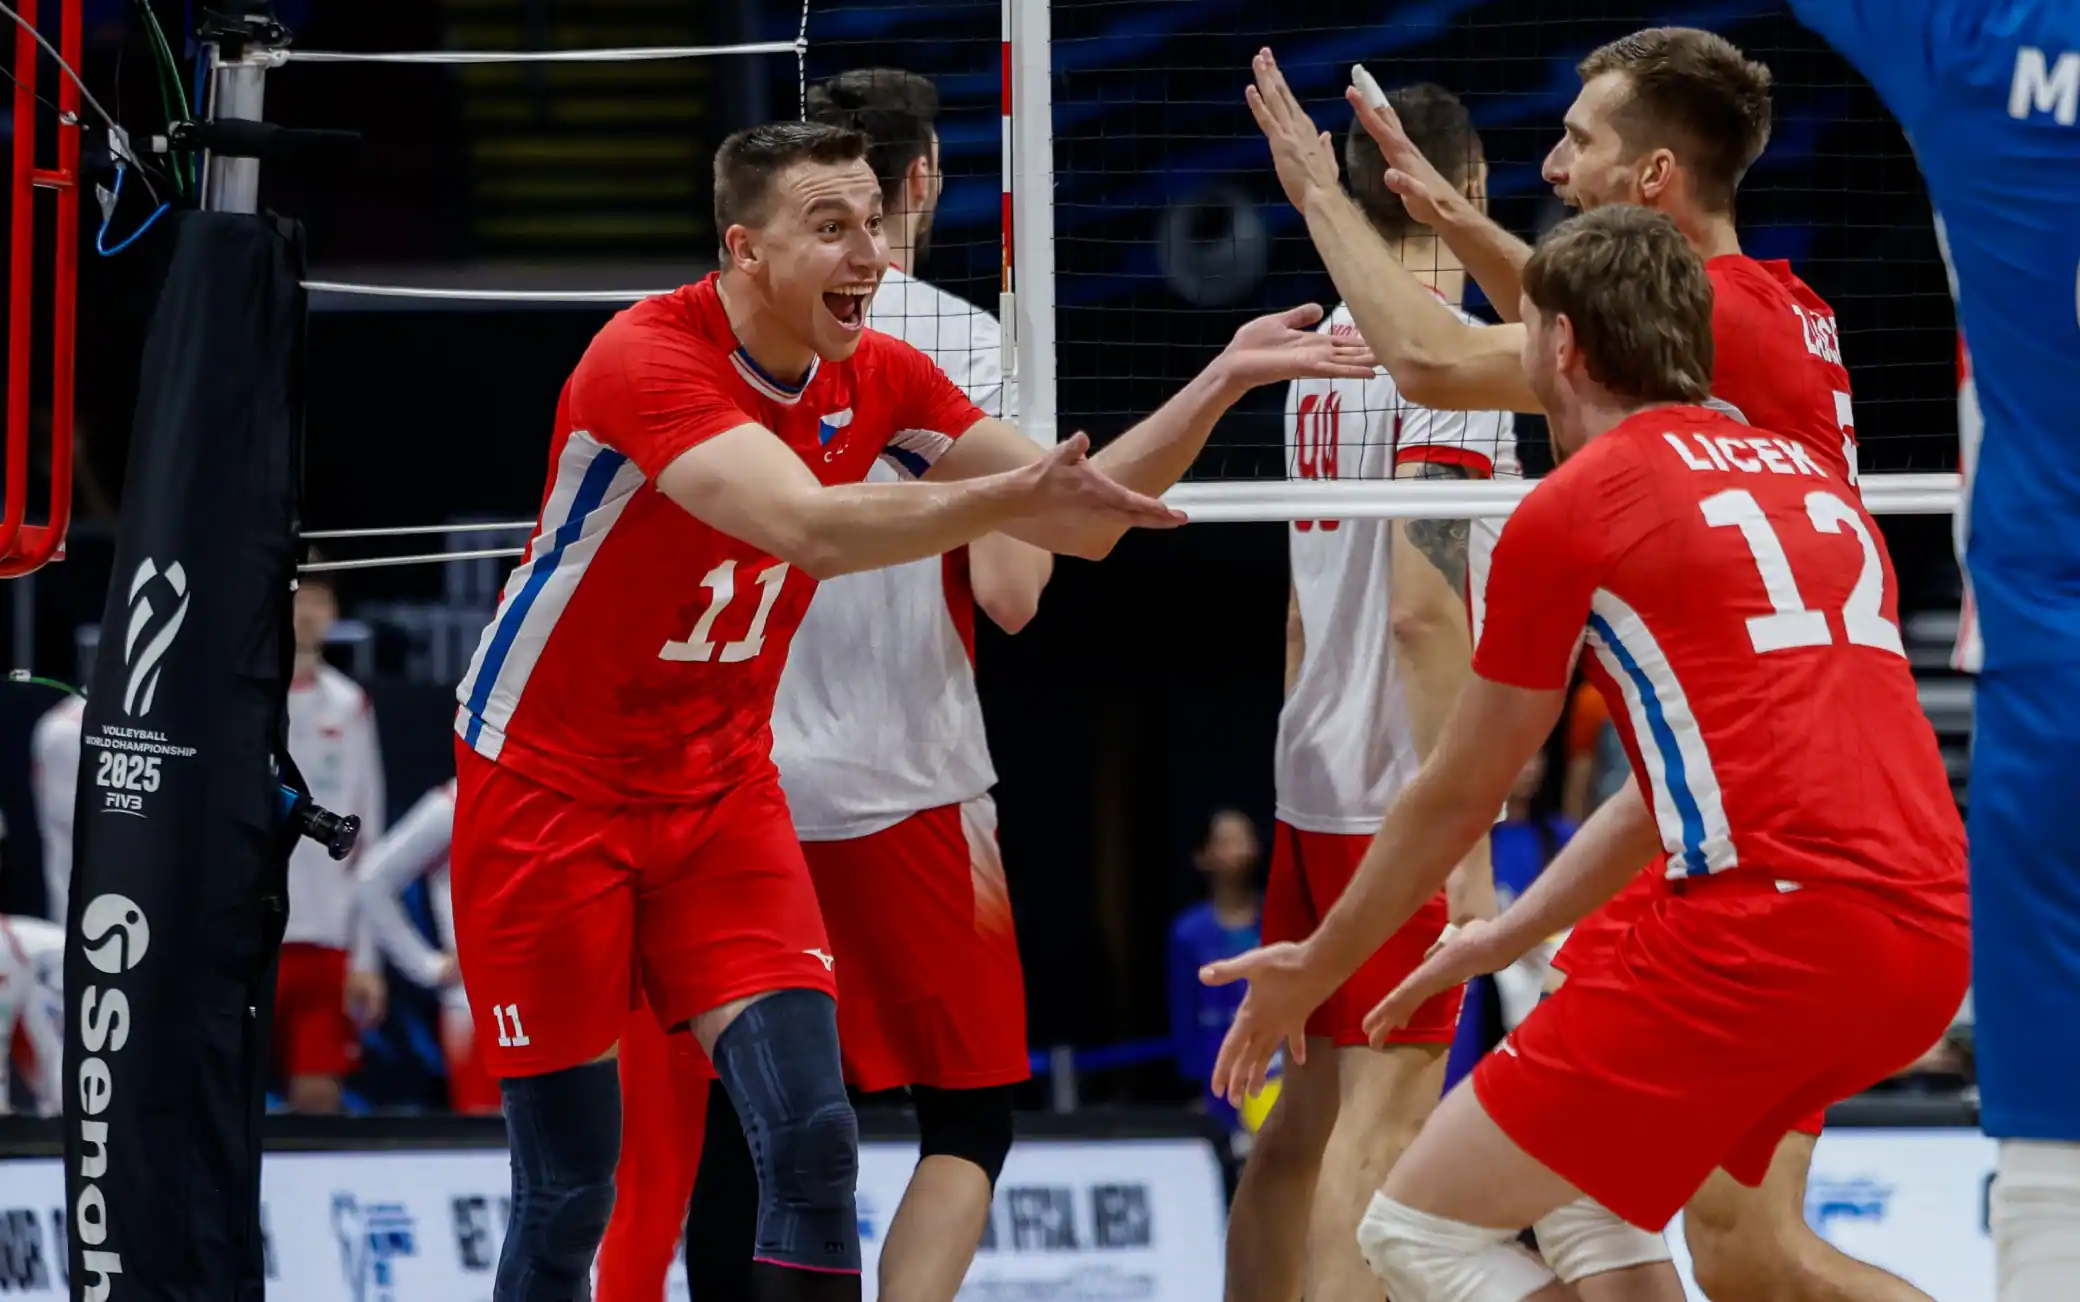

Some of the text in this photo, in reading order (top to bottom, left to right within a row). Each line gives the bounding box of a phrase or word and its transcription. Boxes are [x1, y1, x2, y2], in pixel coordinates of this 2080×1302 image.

[1663, 431, 1828, 478] LICEK
[1698, 488, 1907, 658] 12
[658, 559, 791, 663] 11
[86, 735, 197, 757] WORLD CHAMPIONSHIP
[102, 725, 168, 741] VOLLEYBALL
[96, 750, 162, 793] 2025
[492, 1003, 530, 1047] 11
[77, 985, 130, 1302] Senoh
